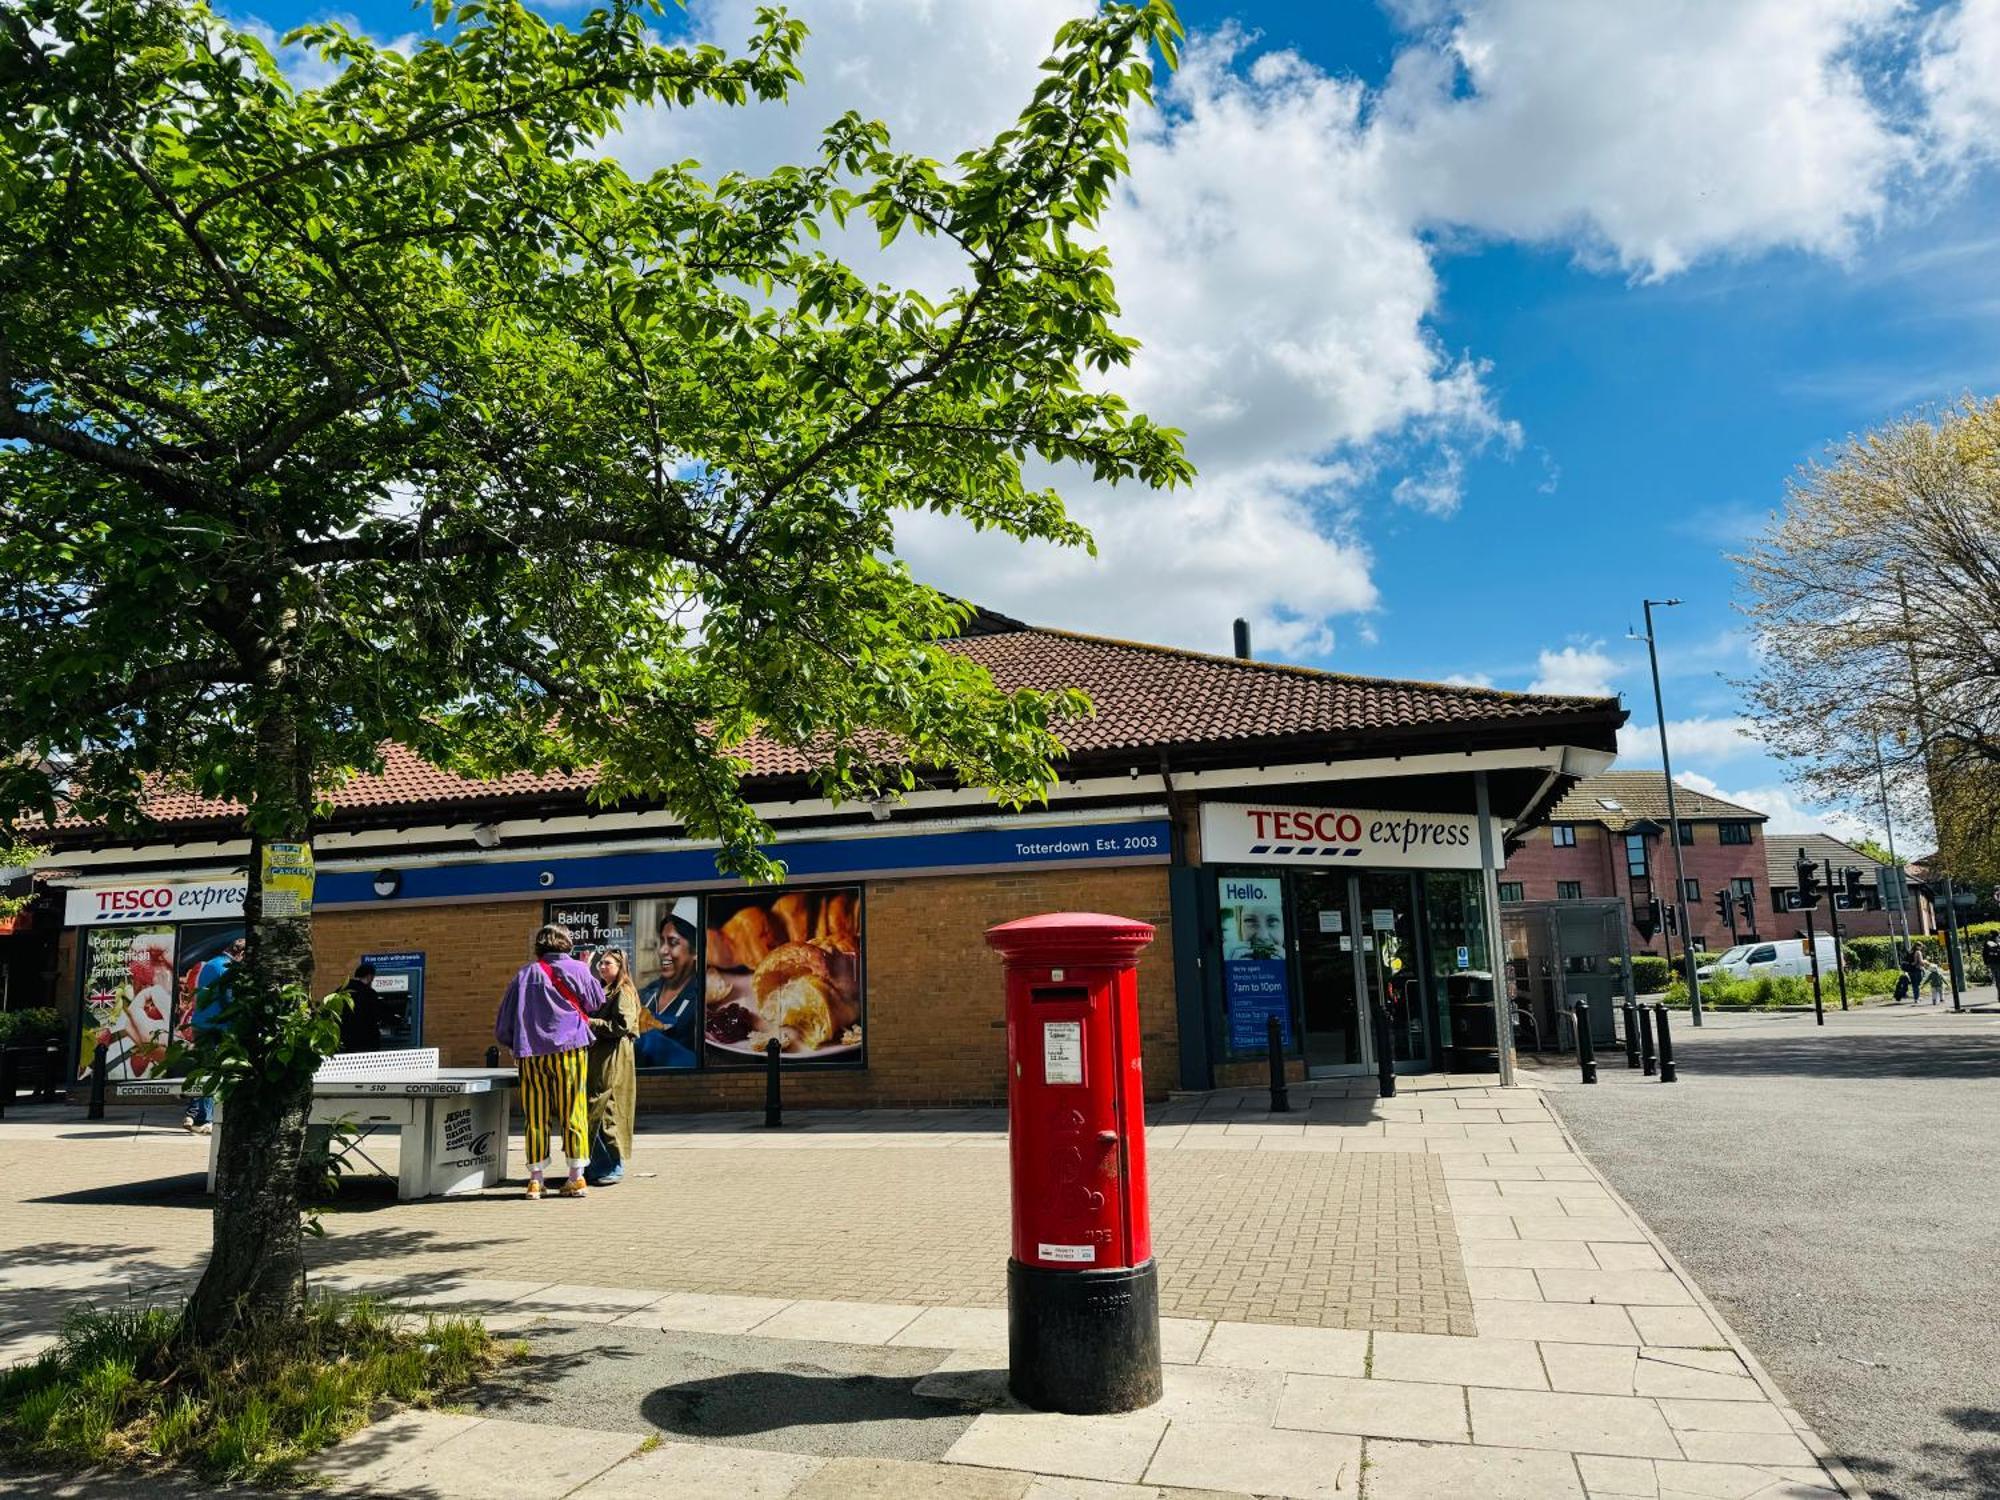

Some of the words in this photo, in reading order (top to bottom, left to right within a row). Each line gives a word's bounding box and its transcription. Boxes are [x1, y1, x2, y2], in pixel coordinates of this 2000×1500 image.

[1248, 811, 1362, 842] TESCO
[1370, 818, 1469, 853] express
[1016, 840, 1089, 855] Totterdown
[1096, 839, 1120, 850] Est.
[1124, 836, 1157, 849] 2003
[96, 889, 173, 910] TESCO
[178, 886, 246, 912] expres
[1227, 884, 1267, 900] Hello.
[558, 912, 599, 926] Baking
[568, 927, 589, 940] esh
[593, 926, 624, 939] from
[92, 951, 115, 963] with
[117, 950, 150, 962] British
[1233, 982, 1250, 992] 7am
[1251, 983, 1260, 992] to
[1261, 982, 1282, 992] 10pm
[406, 1084, 460, 1093] cornilleau
[444, 1109, 471, 1124] JESUS
